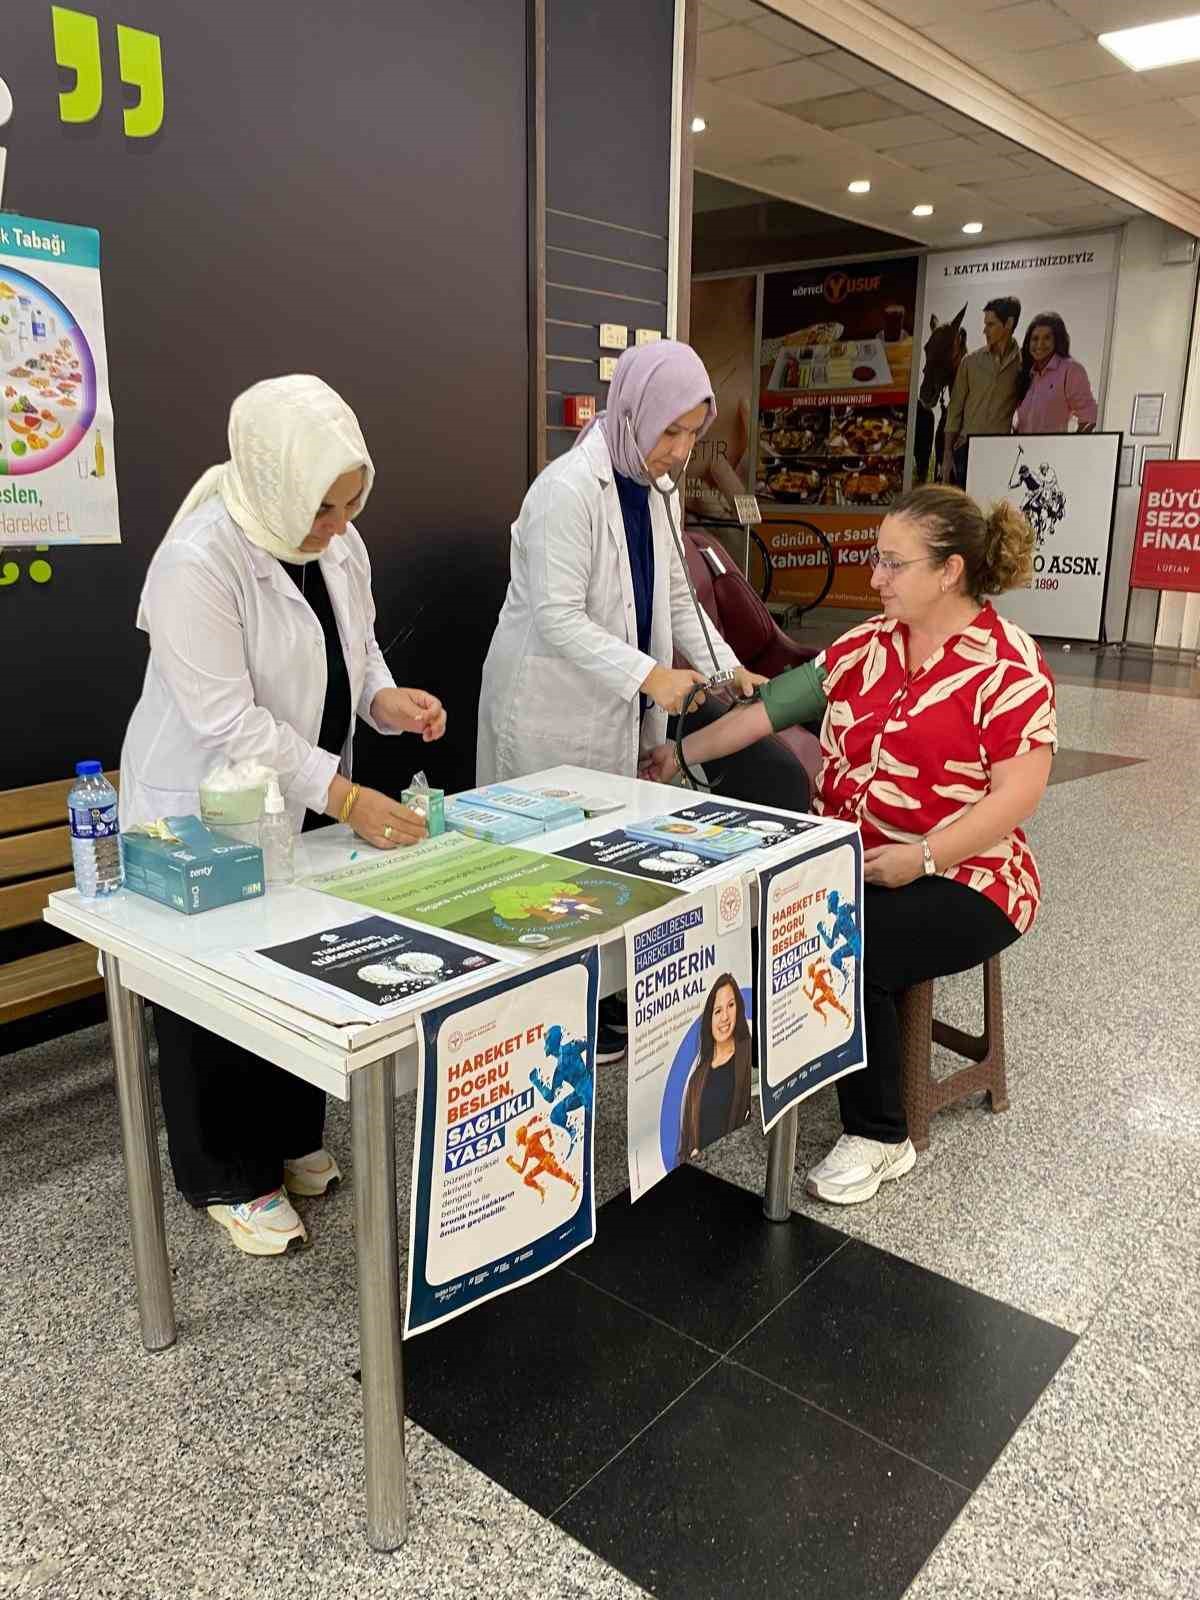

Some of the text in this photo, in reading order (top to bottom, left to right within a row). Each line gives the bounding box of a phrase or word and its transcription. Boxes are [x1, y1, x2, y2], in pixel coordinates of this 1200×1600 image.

[12, 227, 66, 256] Tabağı
[954, 262, 989, 276] KATTA
[771, 532, 813, 547] Günün
[770, 549, 830, 568] Kahvalt
[1047, 554, 1102, 576] ASSN.
[1034, 578, 1059, 590] 1890
[772, 894, 813, 925] HAREKET
[636, 936, 684, 973] HAREKET ET
[635, 944, 716, 1006] ÇEMBERİN
[635, 977, 707, 1028] DIŞINDA KAL
[448, 1033, 523, 1083] HAREKET
